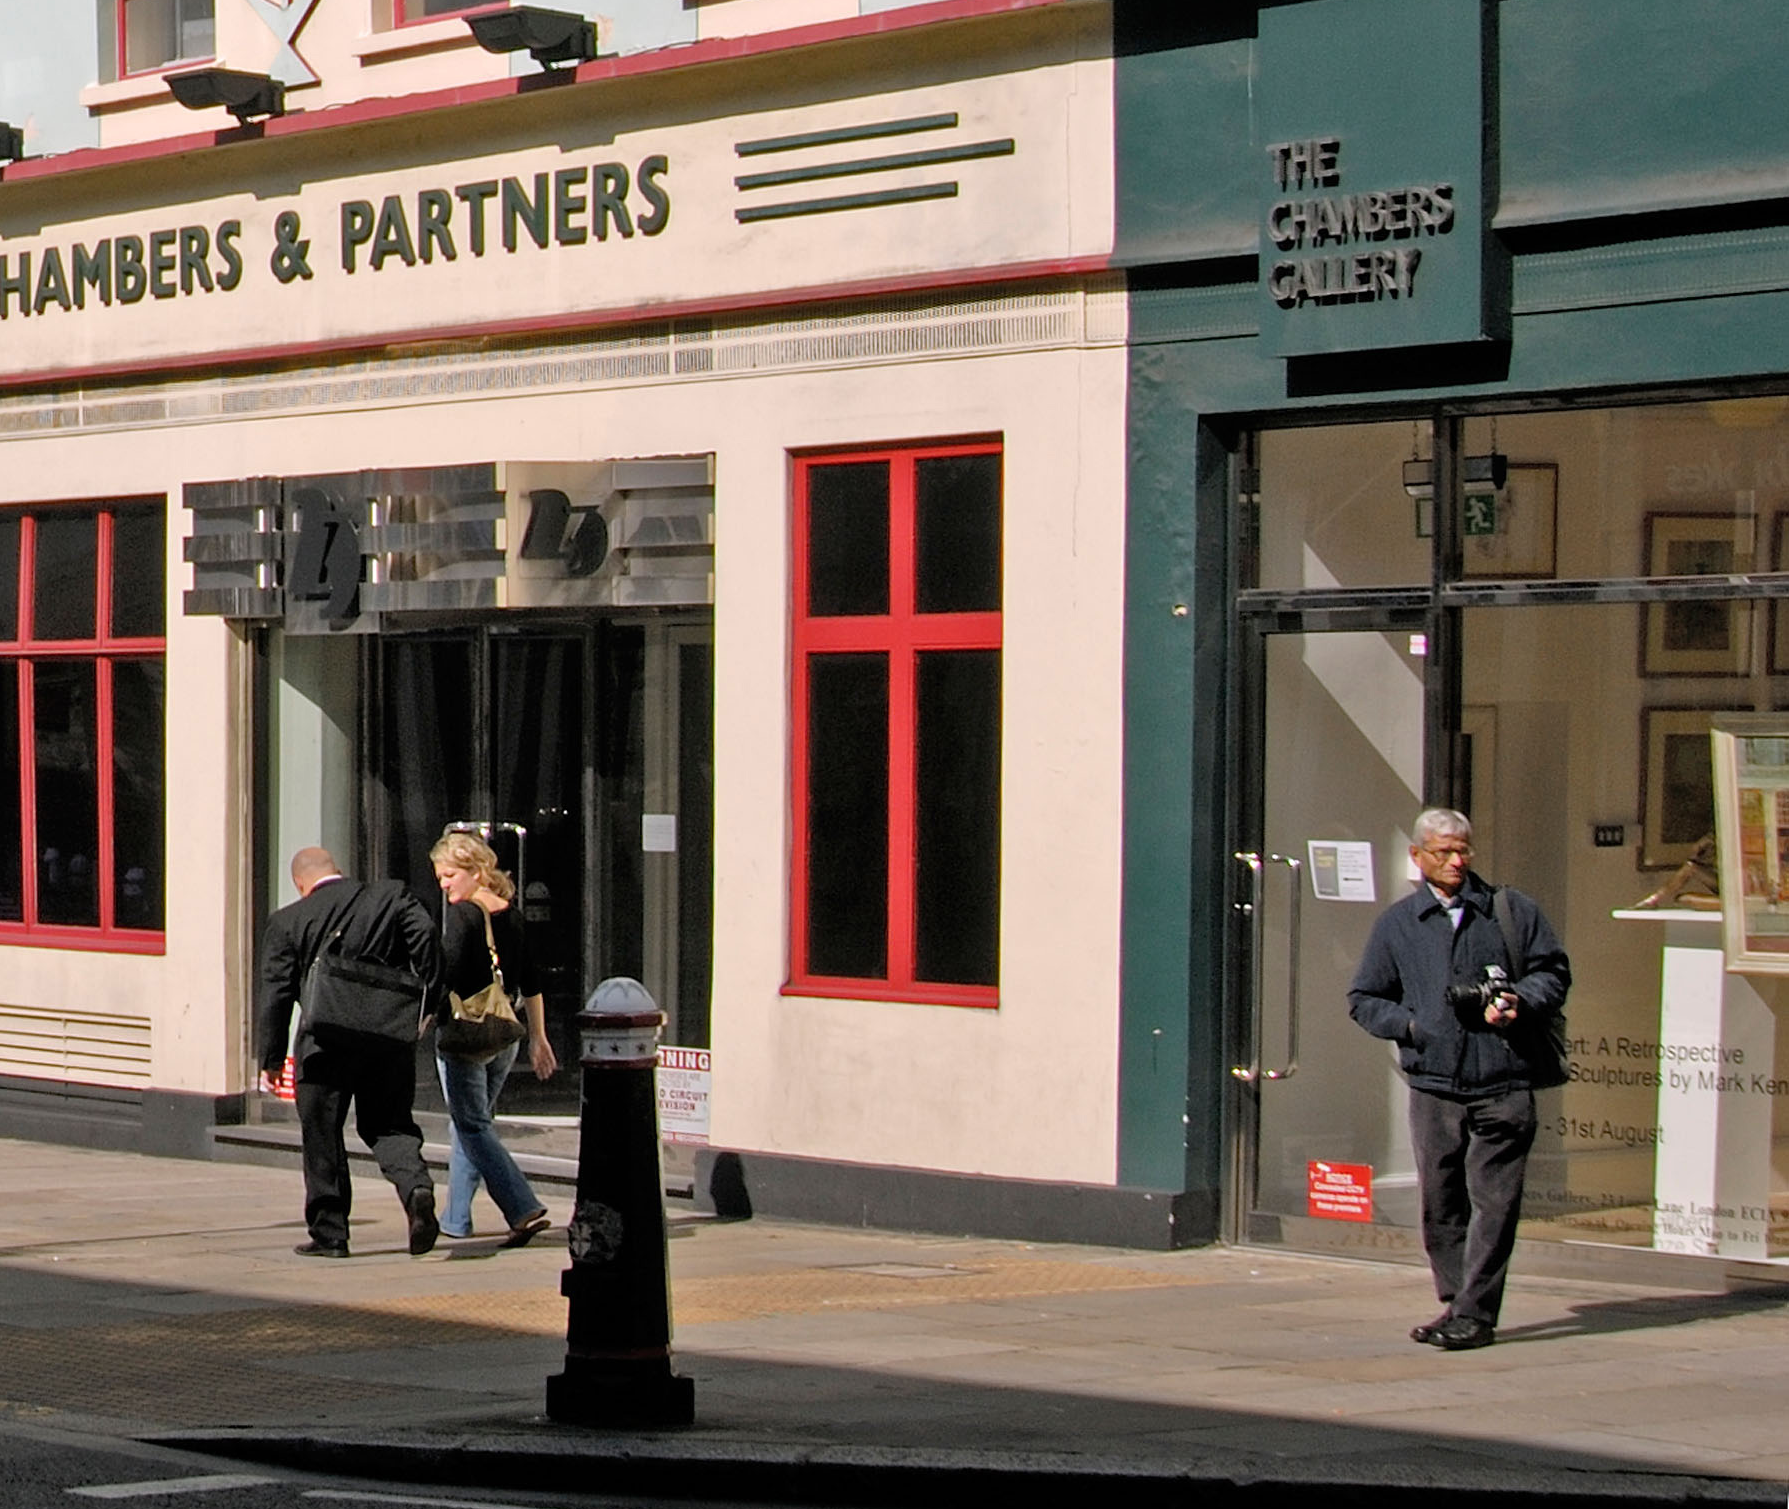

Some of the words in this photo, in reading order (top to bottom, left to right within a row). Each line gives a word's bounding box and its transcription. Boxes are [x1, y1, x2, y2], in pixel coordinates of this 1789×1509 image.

[1266, 137, 1340, 188] THE
[270, 211, 313, 283] &
[340, 155, 670, 274] PARTNERS
[1268, 183, 1454, 249] CHAMBERS
[1268, 247, 1422, 309] GALLERY
[658, 1049, 710, 1071] NING
[1565, 1039, 1590, 1055] ert:
[1597, 1038, 1611, 1055] A
[1617, 1037, 1744, 1064] Retrospective
[1569, 1062, 1663, 1088] Sculptures
[1670, 1069, 1693, 1093] by
[1698, 1071, 1745, 1093] Mark
[1751, 1073, 1789, 1096] Ken
[659, 1099, 696, 1111] EVISION
[670, 1089, 708, 1101] CIRCUIT
[1557, 1116, 1595, 1139] 31st
[1600, 1120, 1665, 1147] August
[1691, 1201, 1735, 1219] London
